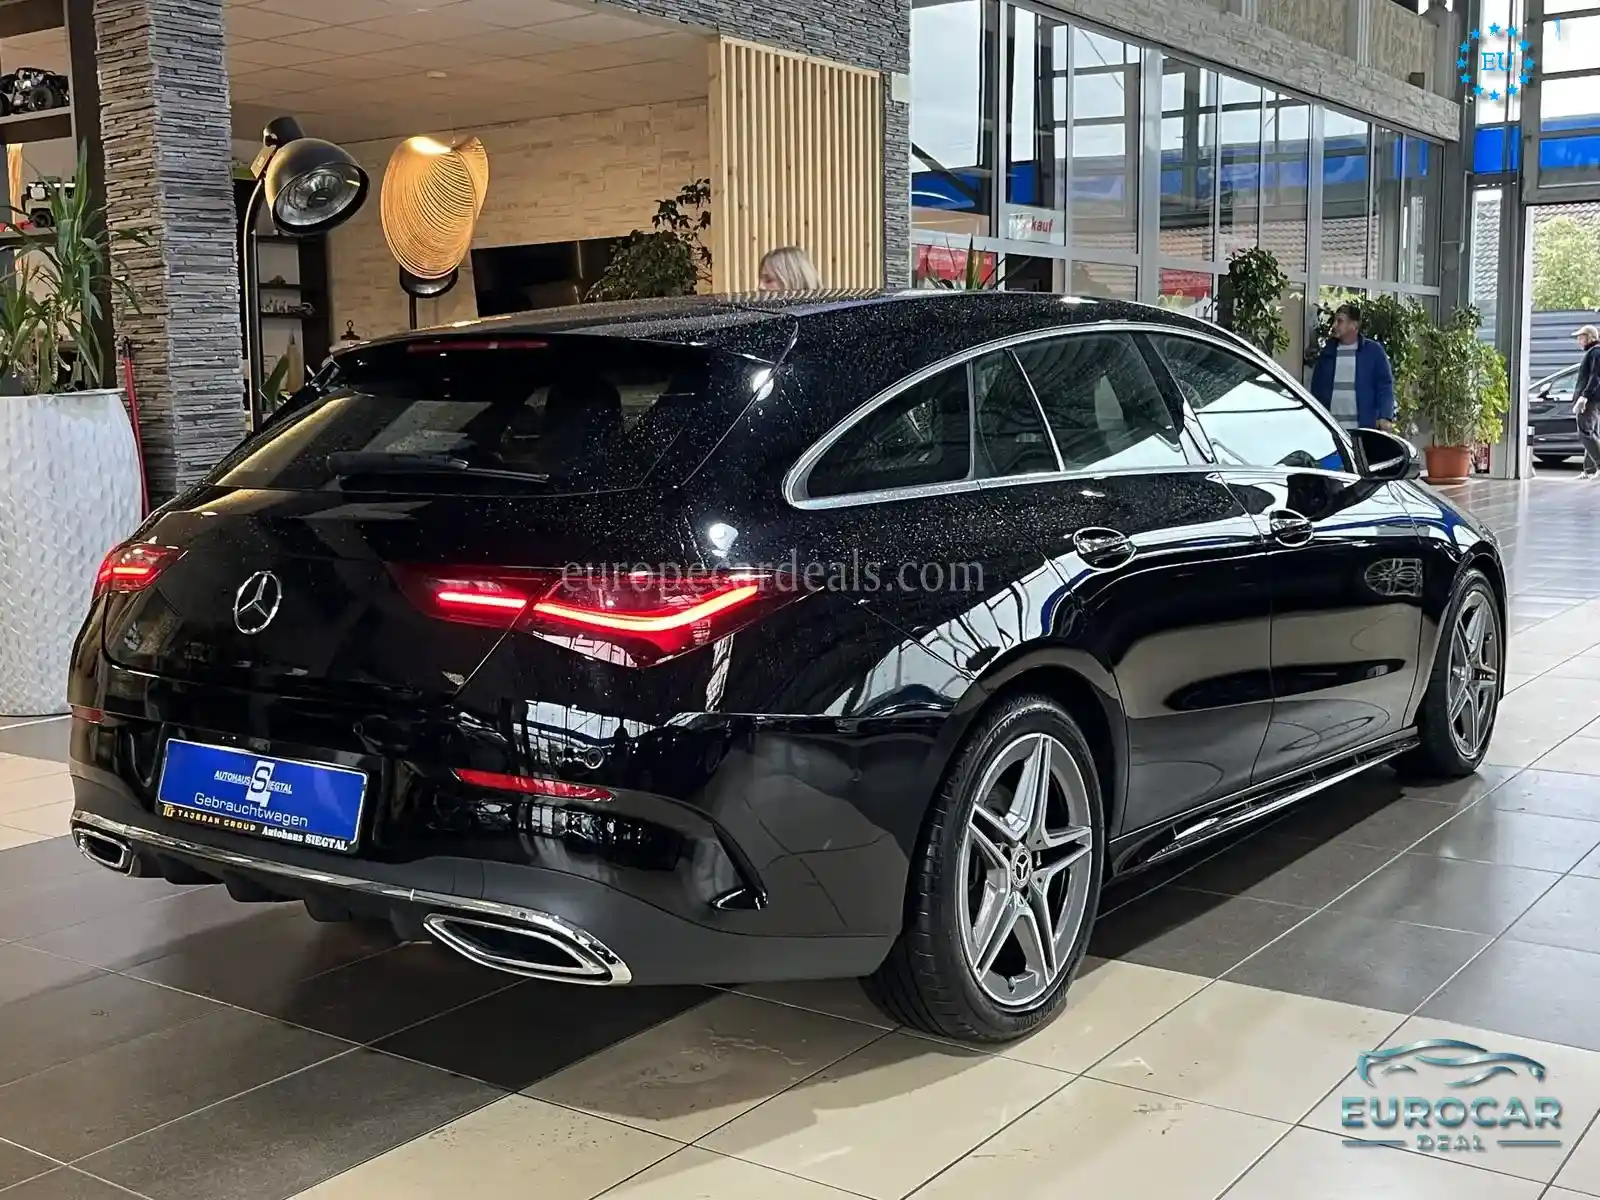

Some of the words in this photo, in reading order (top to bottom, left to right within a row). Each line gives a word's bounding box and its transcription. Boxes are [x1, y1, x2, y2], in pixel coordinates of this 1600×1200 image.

[214, 770, 251, 787] AUTOHAUS
[194, 792, 309, 828] Gebrauchtwagen
[261, 825, 304, 842] Autohaus
[305, 833, 348, 852] SIEGTAL
